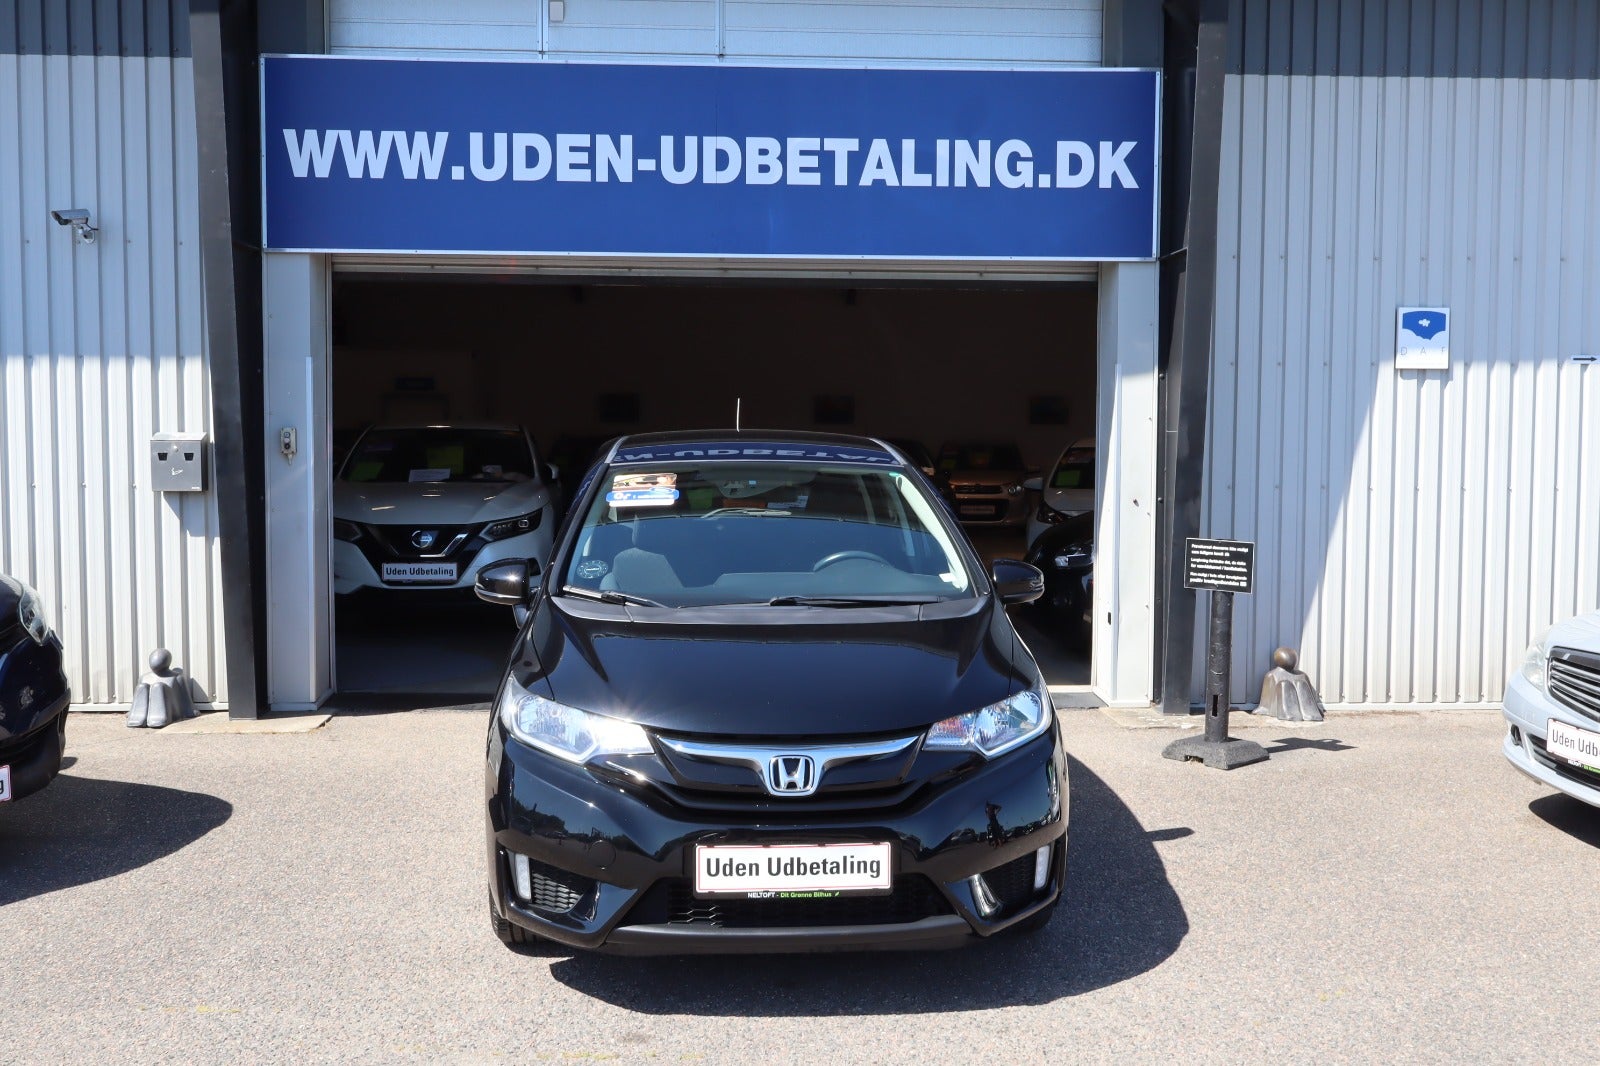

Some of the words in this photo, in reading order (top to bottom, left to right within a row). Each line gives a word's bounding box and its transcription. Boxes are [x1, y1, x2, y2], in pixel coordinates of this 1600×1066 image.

[282, 128, 1139, 189] WWW.UDEN-UDBETALING.DK
[386, 567, 407, 575] Uden
[409, 567, 454, 577] Udbetaling
[1552, 729, 1575, 749] Uden
[1578, 737, 1600, 757] Udb
[706, 857, 760, 877] Uden
[767, 855, 881, 879] Udbetaling
